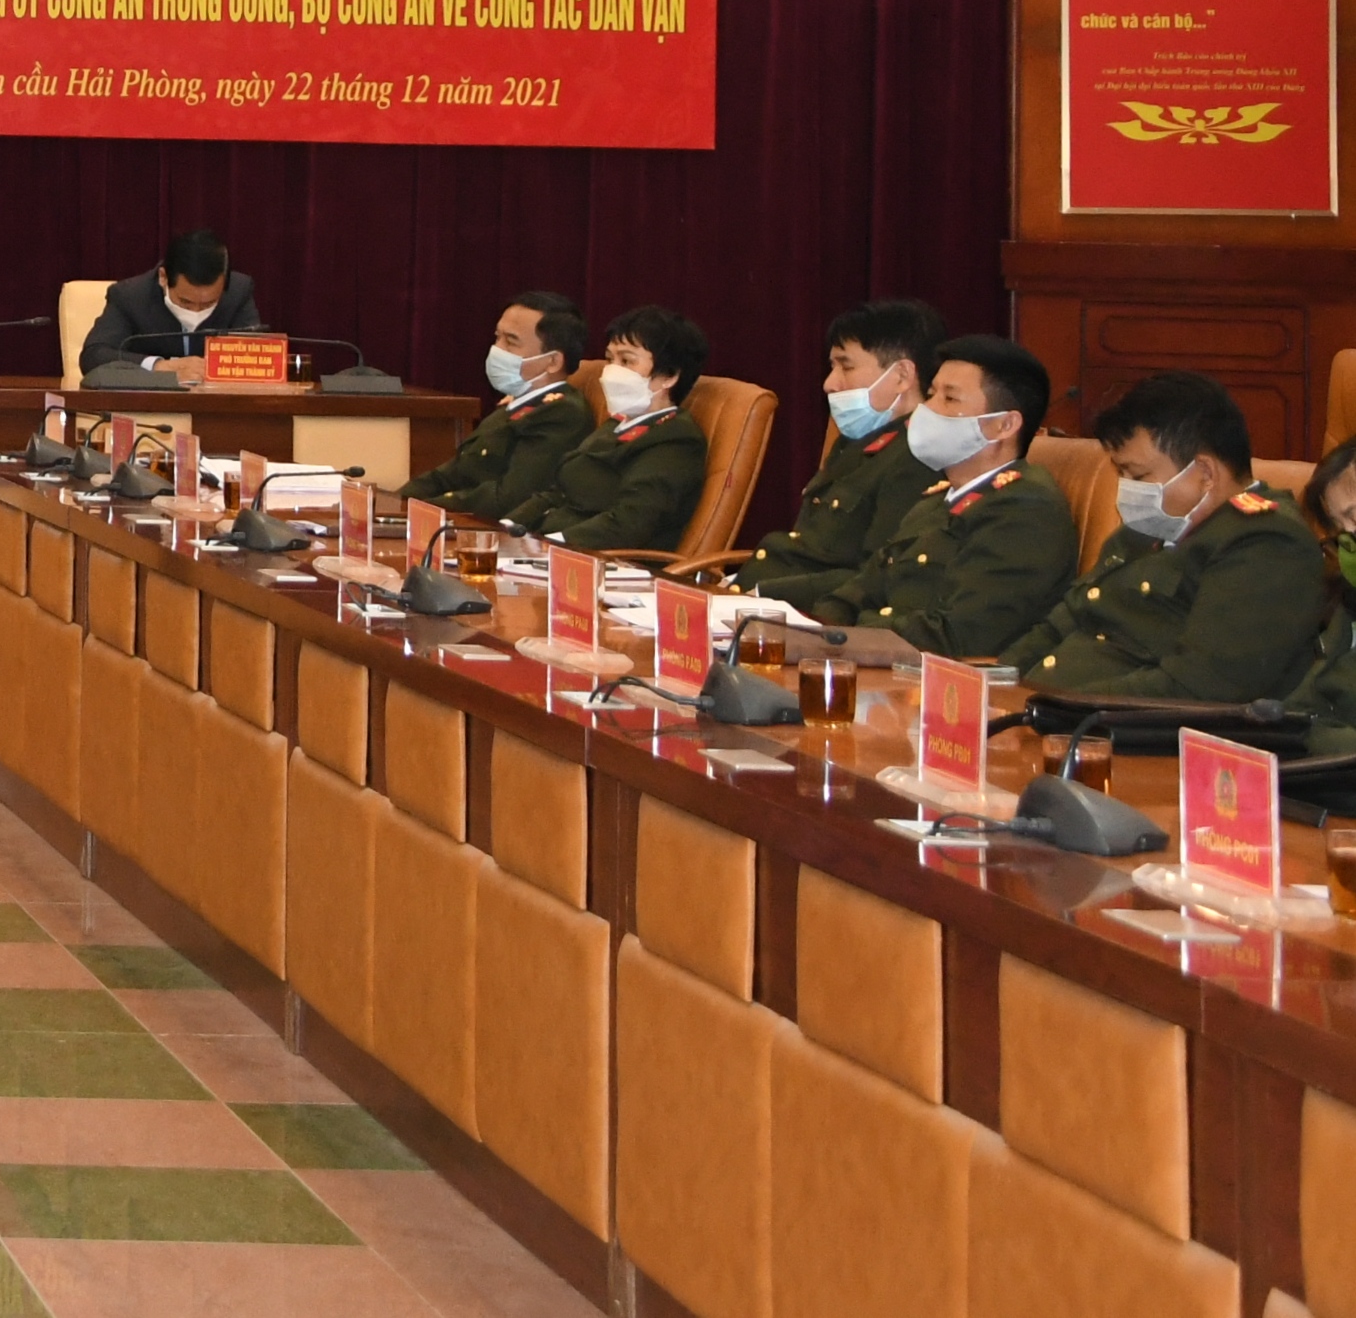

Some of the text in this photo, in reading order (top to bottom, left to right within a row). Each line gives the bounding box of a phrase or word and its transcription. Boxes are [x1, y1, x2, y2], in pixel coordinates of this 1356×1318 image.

[14, 63, 56, 94] cầu
[67, 69, 112, 95] Hải
[122, 70, 205, 104] Phòng,
[217, 74, 274, 106] ngày
[283, 73, 311, 99] 22
[322, 74, 392, 108] tháng
[403, 76, 429, 102] 12
[439, 80, 491, 103] năm
[502, 78, 559, 105] 2021
